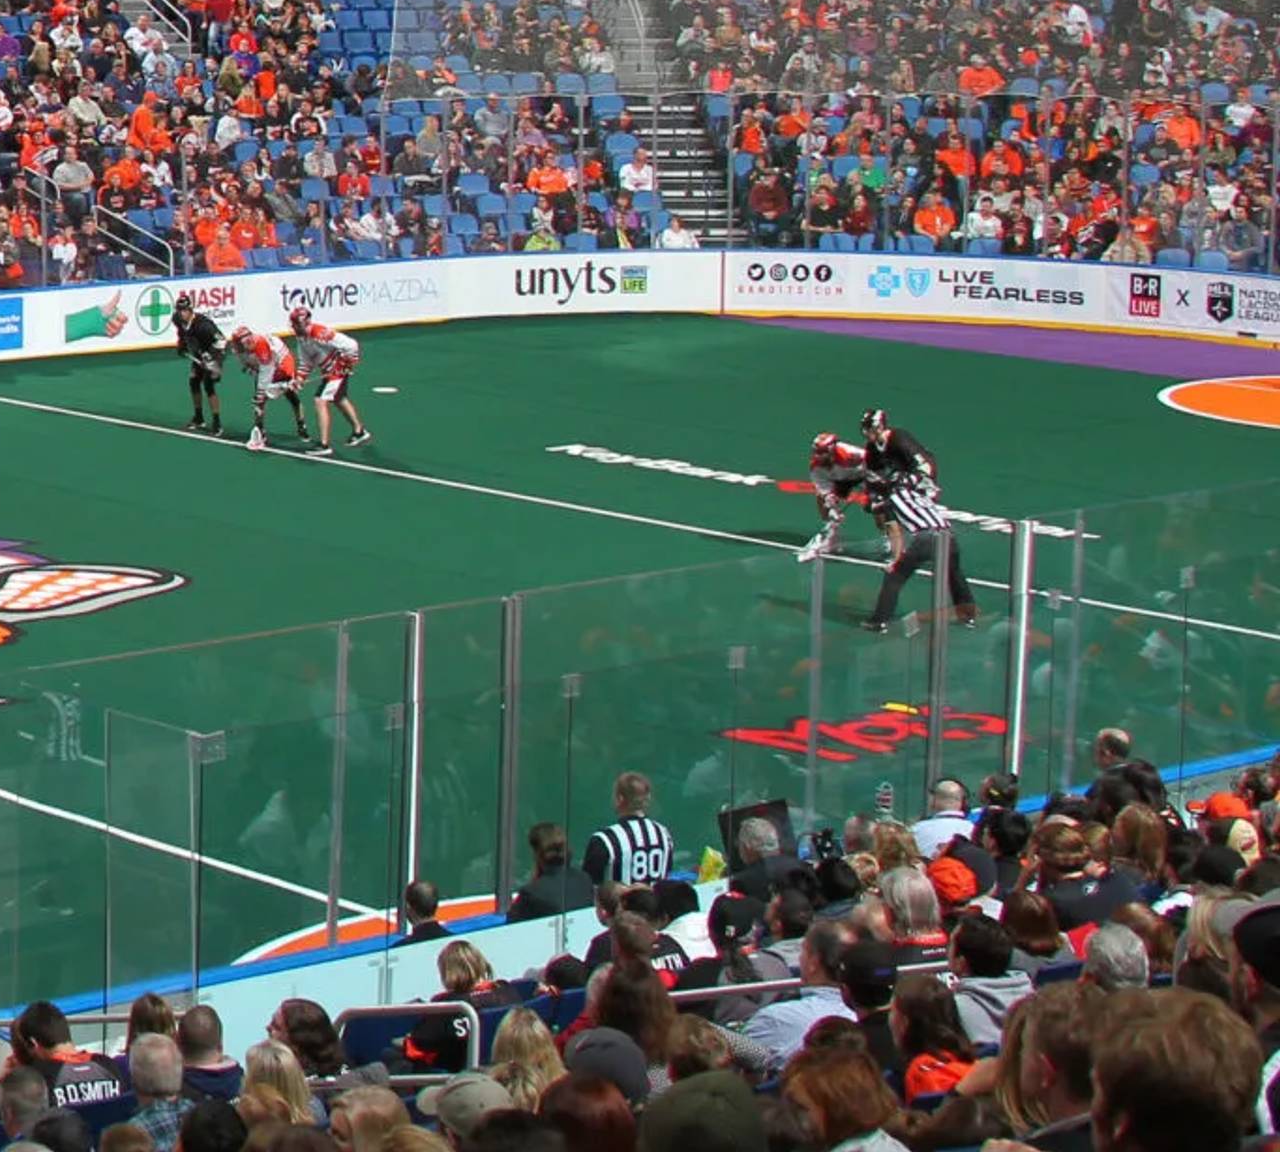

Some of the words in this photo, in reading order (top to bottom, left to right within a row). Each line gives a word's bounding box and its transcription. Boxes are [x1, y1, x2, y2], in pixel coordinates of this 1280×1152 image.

[515, 260, 617, 305] unyts
[938, 269, 995, 285] LIVE
[178, 286, 235, 308] MASH
[953, 285, 1084, 306] FEARLESS
[1176, 289, 1190, 307] X
[1131, 300, 1159, 316] LIVE
[633, 849, 663, 880] 80
